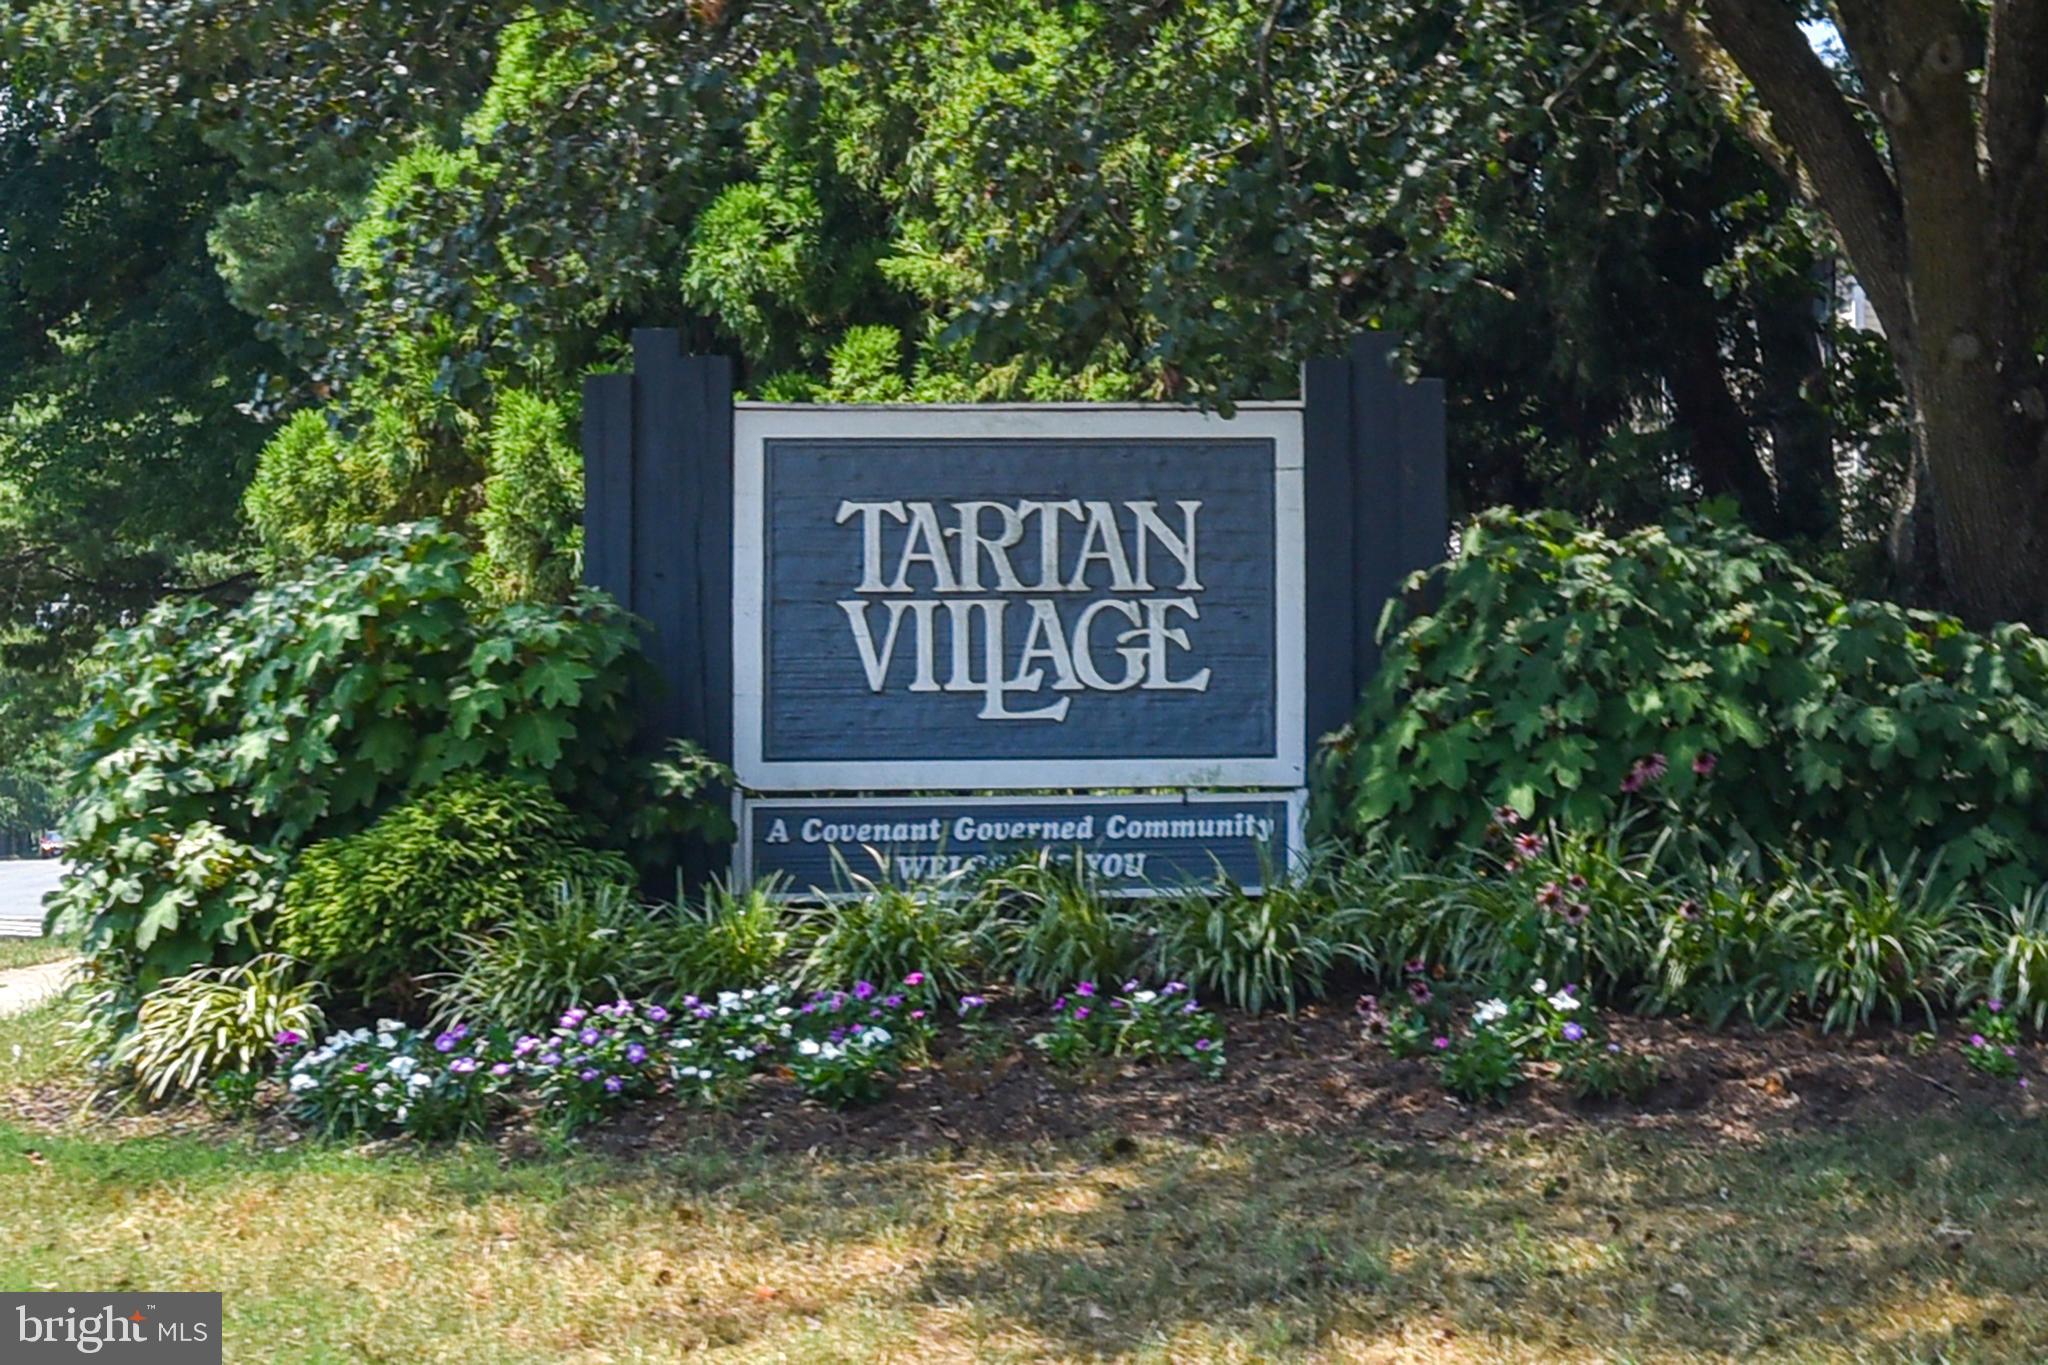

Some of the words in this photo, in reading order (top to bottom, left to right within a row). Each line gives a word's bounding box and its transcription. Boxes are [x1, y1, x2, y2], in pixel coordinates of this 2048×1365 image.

[835, 500, 1203, 593] TARTAN
[836, 597, 1211, 722] VILLAGE
[765, 818, 790, 843] A
[801, 817, 941, 843] Covenant
[953, 815, 1094, 842] Governed
[1106, 813, 1275, 842] Community
